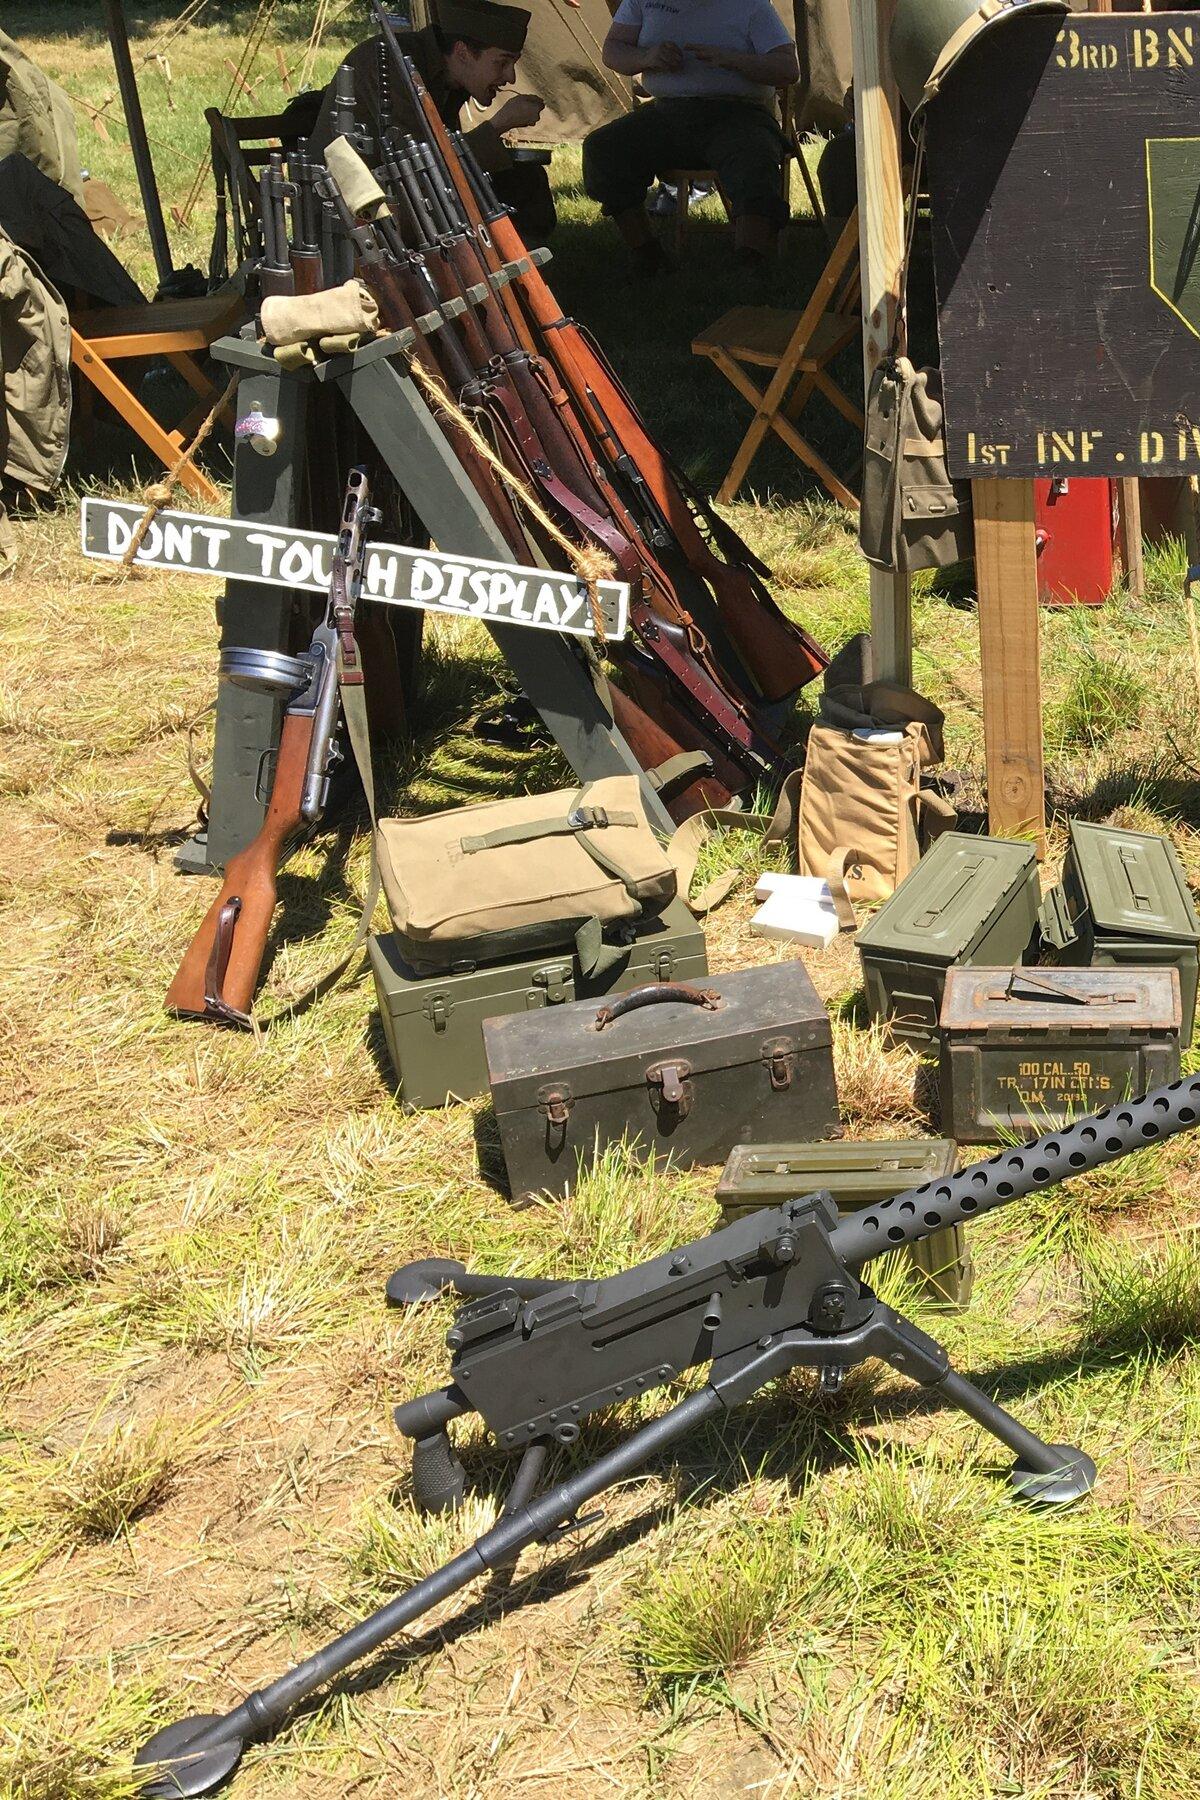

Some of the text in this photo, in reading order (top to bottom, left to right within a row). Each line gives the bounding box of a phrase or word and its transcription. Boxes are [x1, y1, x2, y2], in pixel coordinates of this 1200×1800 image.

[1056, 29, 1118, 69] 3RD
[1037, 430, 1125, 464] INF.
[107, 511, 231, 568] DON'T
[247, 533, 398, 598] TOUH
